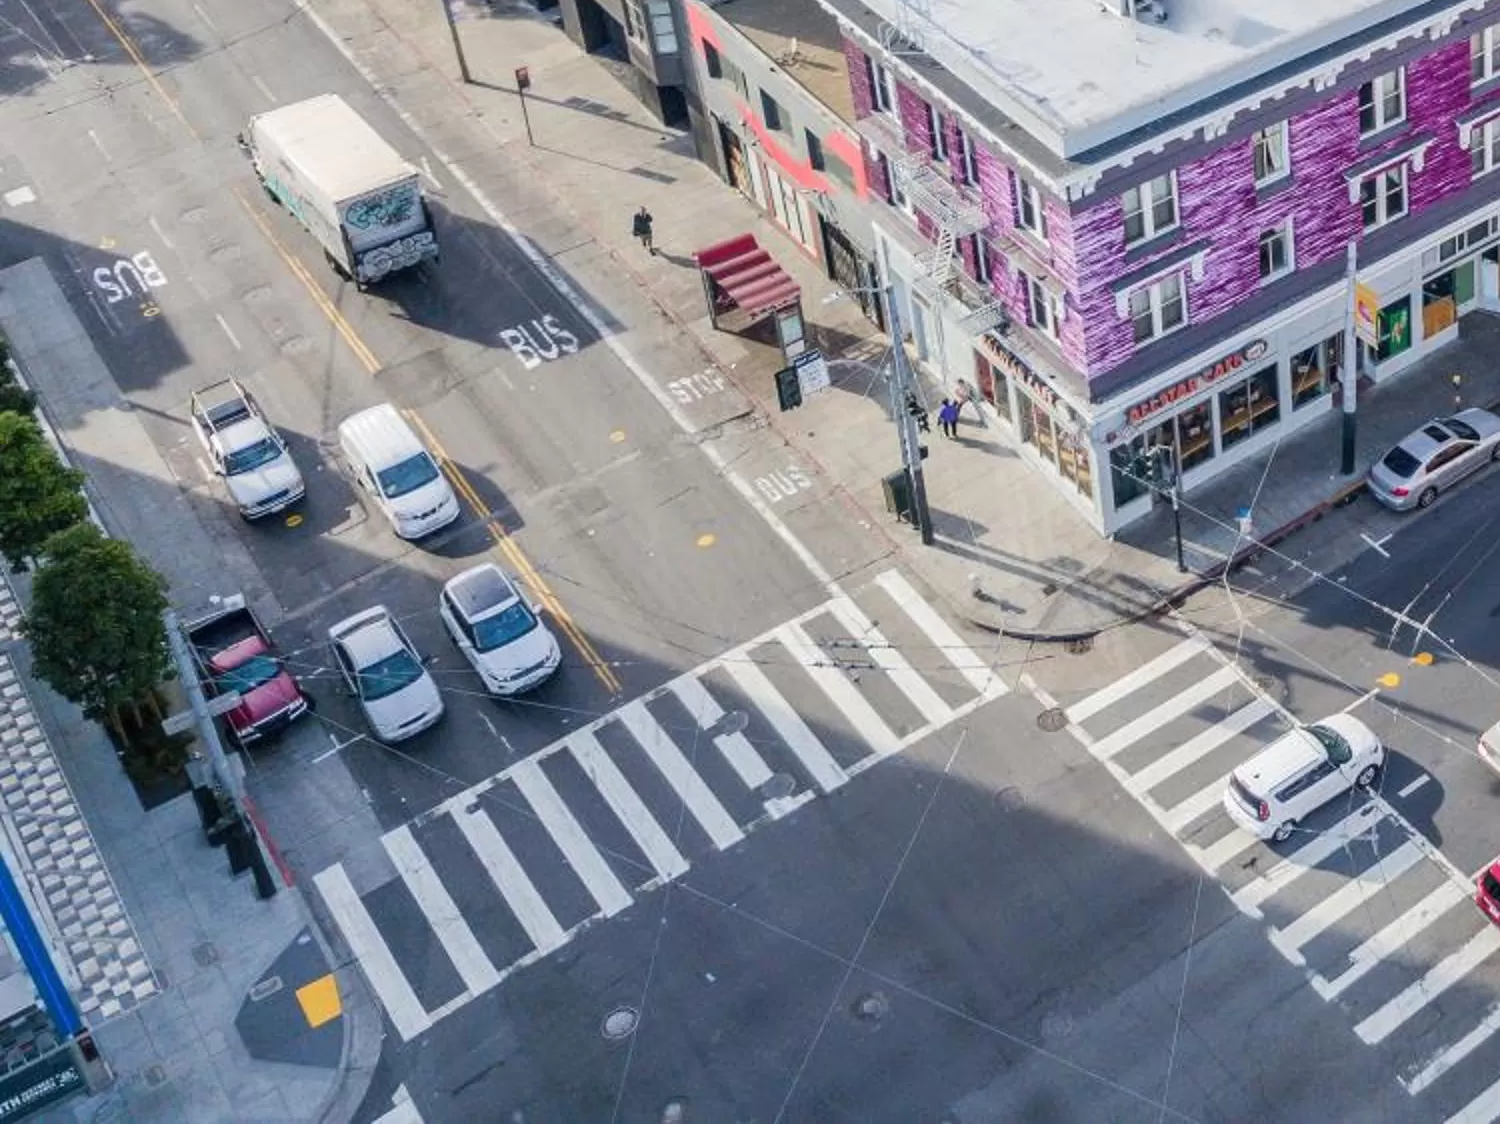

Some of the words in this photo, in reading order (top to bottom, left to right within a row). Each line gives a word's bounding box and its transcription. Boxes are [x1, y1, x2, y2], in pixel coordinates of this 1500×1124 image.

[93, 251, 168, 303] BUS
[499, 314, 578, 369] BUS
[755, 465, 812, 503] BUS
